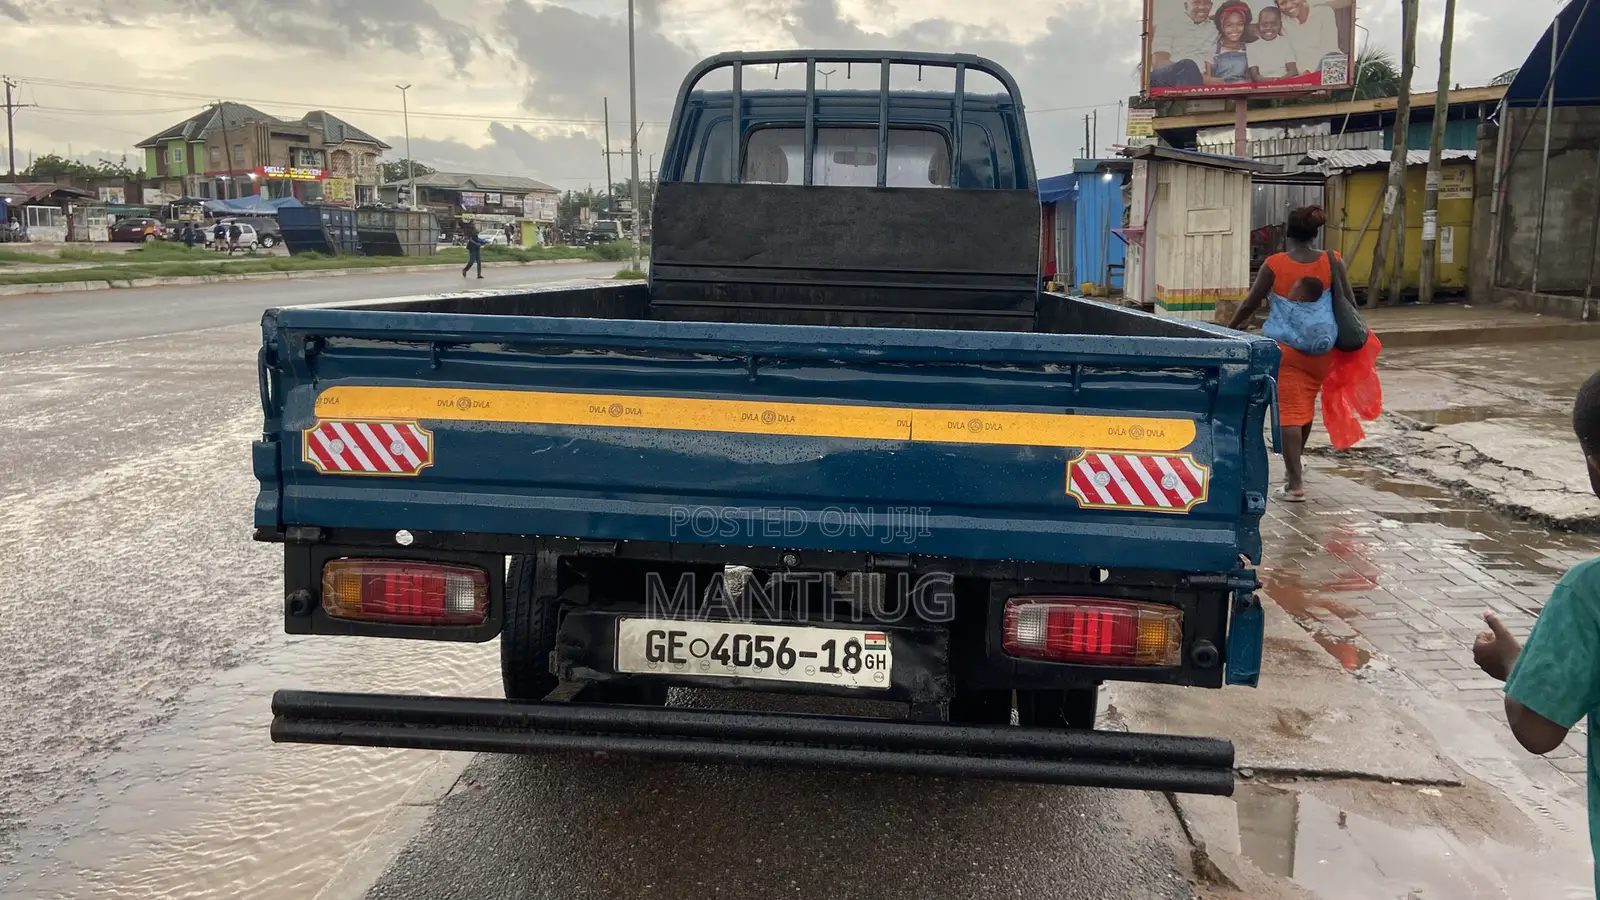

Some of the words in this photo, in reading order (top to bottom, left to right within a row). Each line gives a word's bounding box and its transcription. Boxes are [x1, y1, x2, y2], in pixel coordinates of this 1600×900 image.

[323, 396, 340, 405] DVLA
[437, 399, 454, 408] DVLA
[472, 401, 490, 409] DVLA
[588, 406, 606, 414] DVLA
[625, 407, 642, 416] DVLA
[741, 413, 759, 422] DVLA
[777, 414, 795, 423] DVLA
[947, 421, 965, 430] DVLA
[984, 423, 1003, 432] DVLA
[1108, 427, 1127, 436] DVLA
[1146, 428, 1165, 438] DVLA
[645, 629, 688, 664] GE
[710, 633, 862, 675] 4056-18
[864, 653, 887, 671] GH
